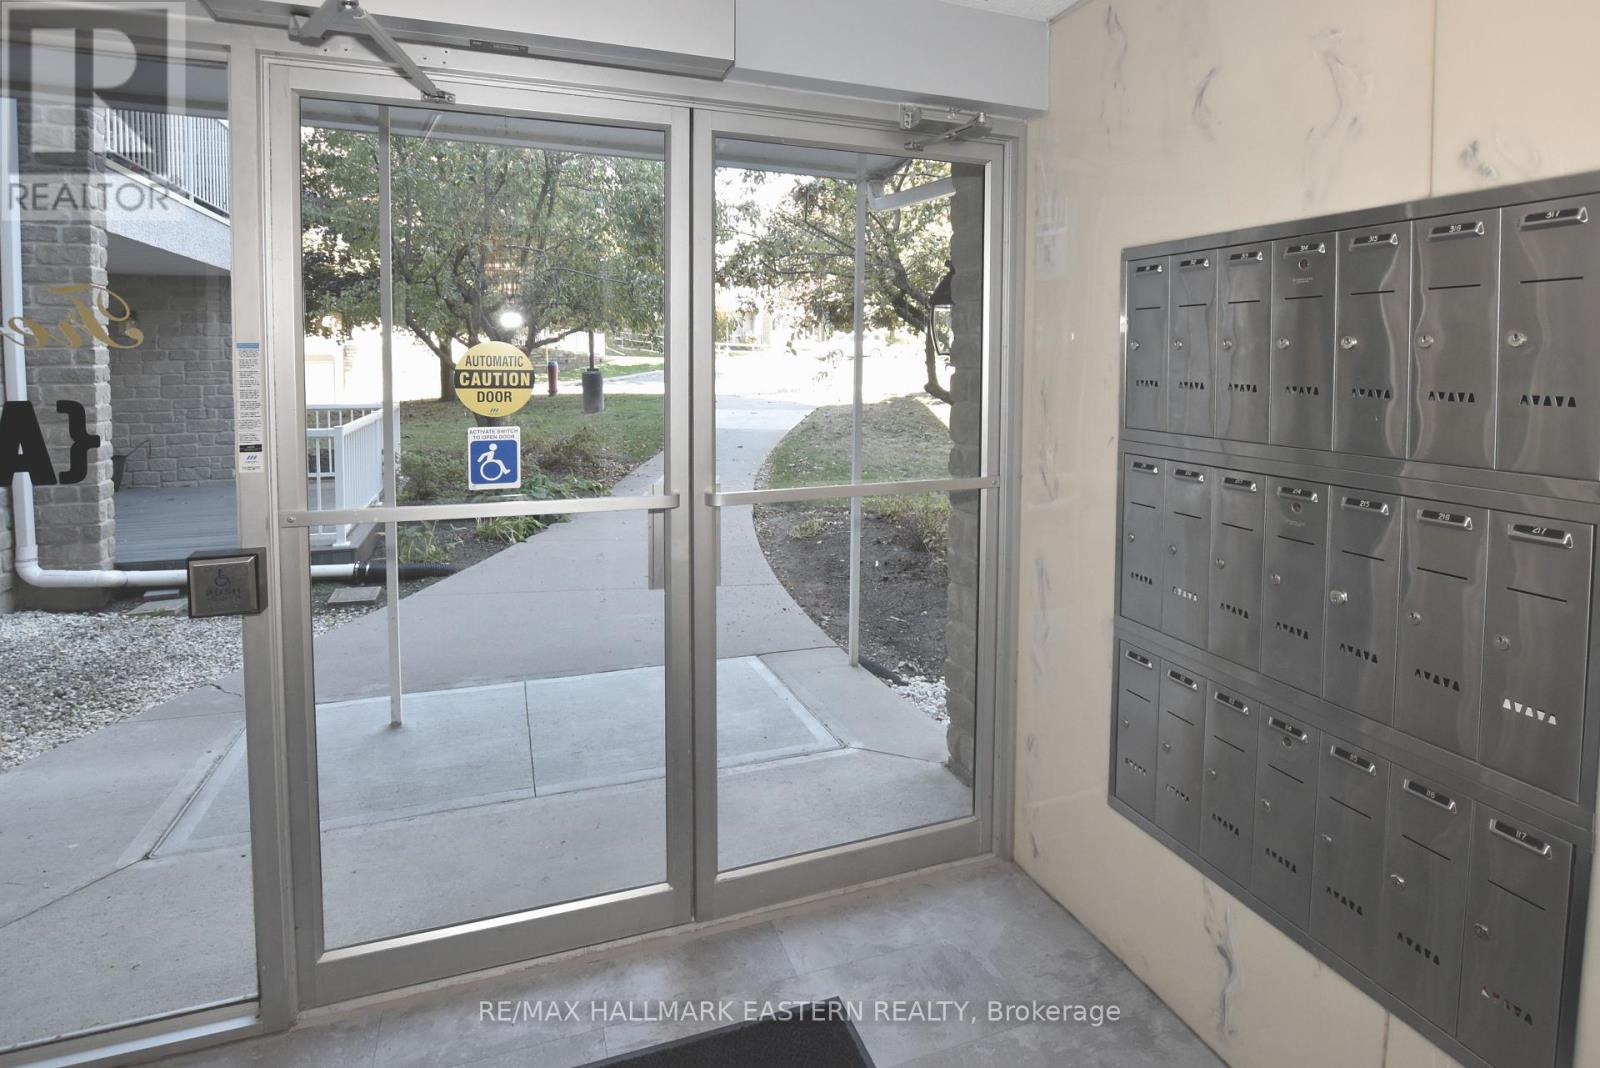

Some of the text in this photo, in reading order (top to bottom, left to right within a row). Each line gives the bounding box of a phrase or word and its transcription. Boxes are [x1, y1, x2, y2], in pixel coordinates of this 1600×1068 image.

[465, 355, 524, 367] AUTOMATIC
[459, 371, 530, 387] CAUTION
[476, 390, 513, 403] DOOR
